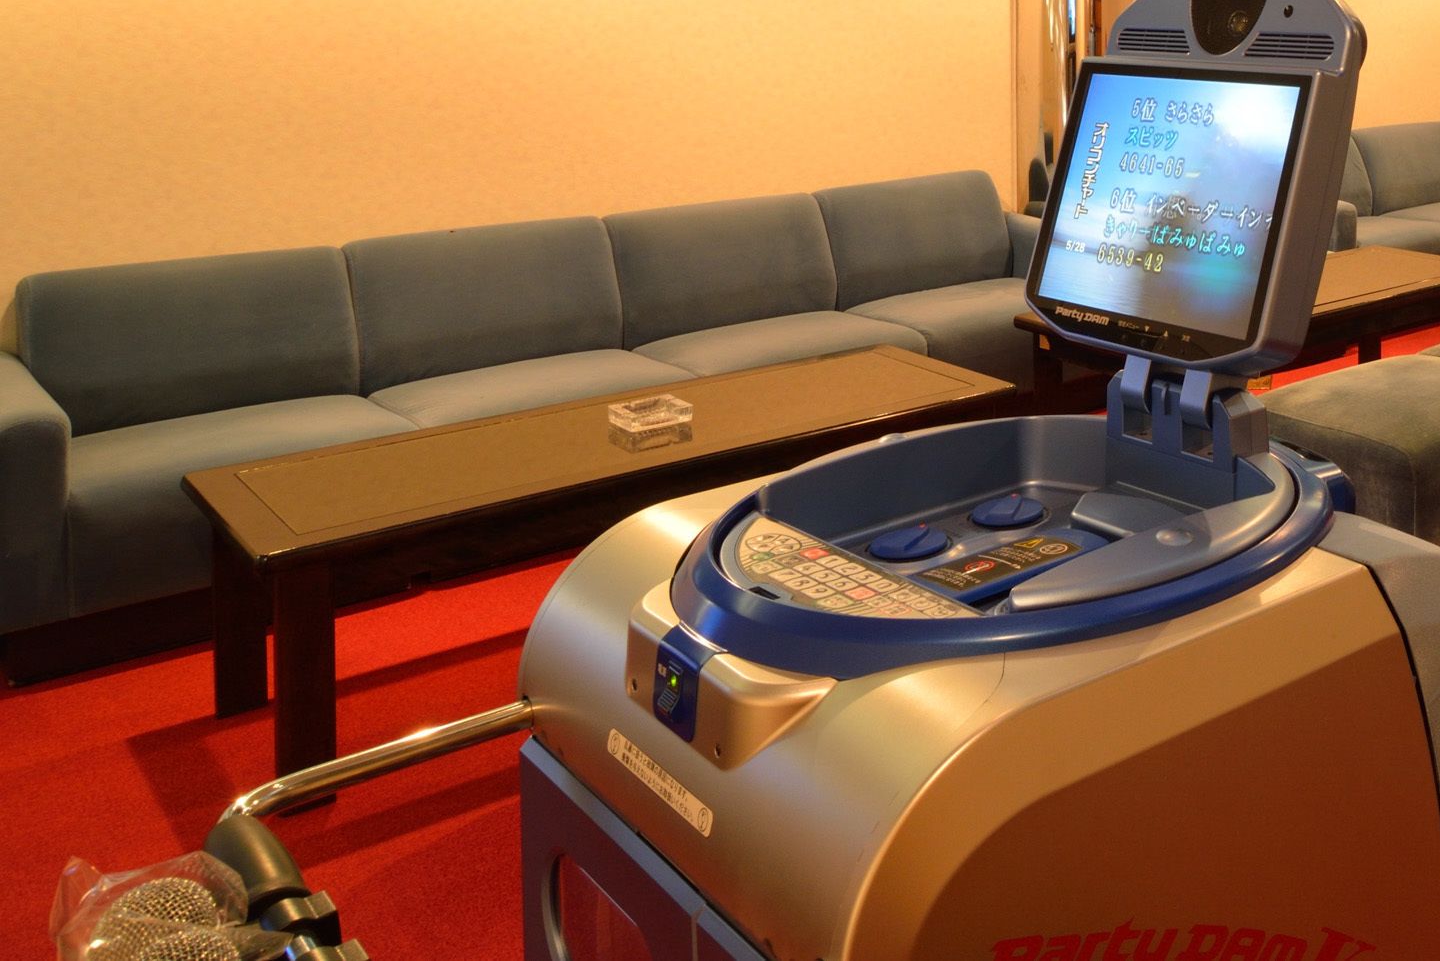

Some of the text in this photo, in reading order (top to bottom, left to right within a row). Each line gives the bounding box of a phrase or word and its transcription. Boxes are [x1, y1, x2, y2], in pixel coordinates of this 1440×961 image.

[1132, 98, 1215, 126] 5位 さらさら
[1120, 152, 1185, 178] 4641-65
[1109, 188, 1137, 213] 6位
[1065, 239, 1086, 253] 5/28
[1096, 243, 1164, 273] 6539-42
